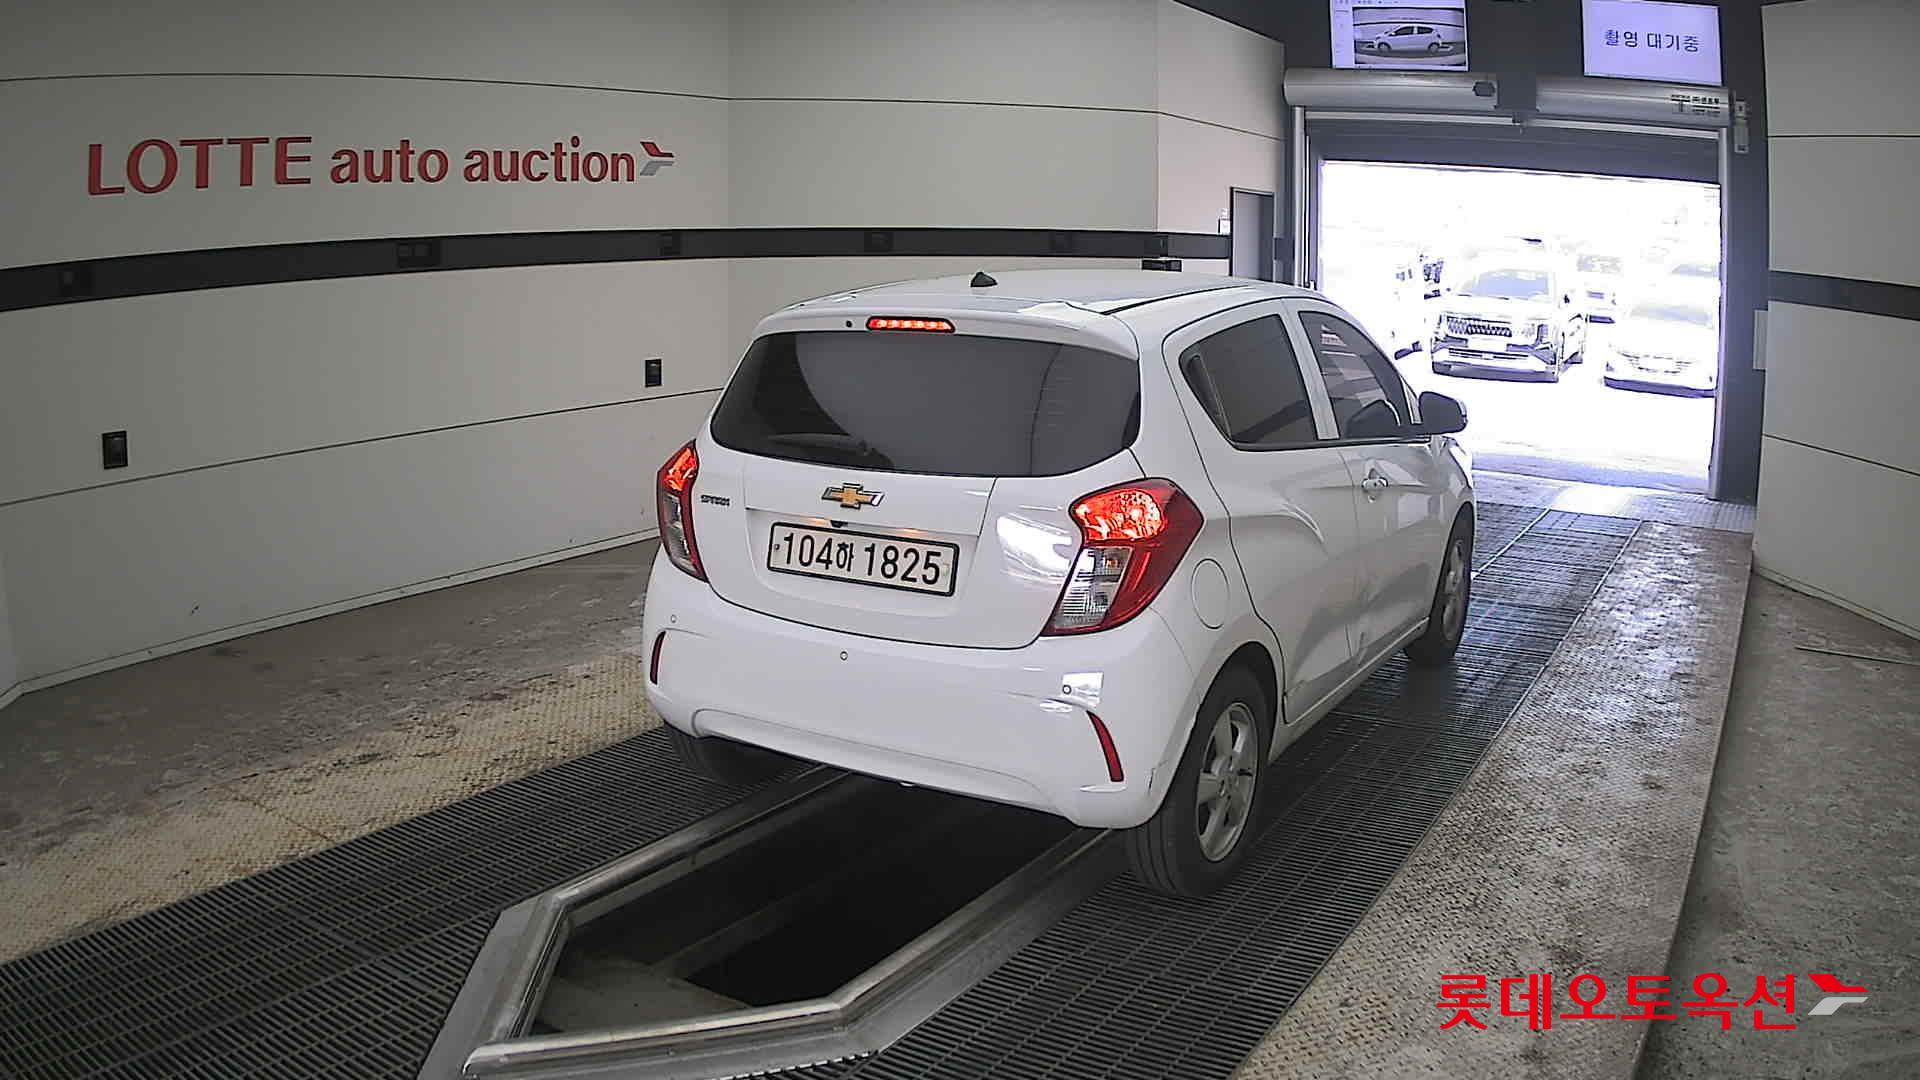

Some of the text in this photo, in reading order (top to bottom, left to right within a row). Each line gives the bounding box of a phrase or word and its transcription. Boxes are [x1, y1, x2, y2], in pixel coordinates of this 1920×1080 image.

[1647, 33, 1699, 52] 대기중
[87, 135, 636, 196] LOTTE auto auction
[783, 532, 942, 586] 104하 1825
